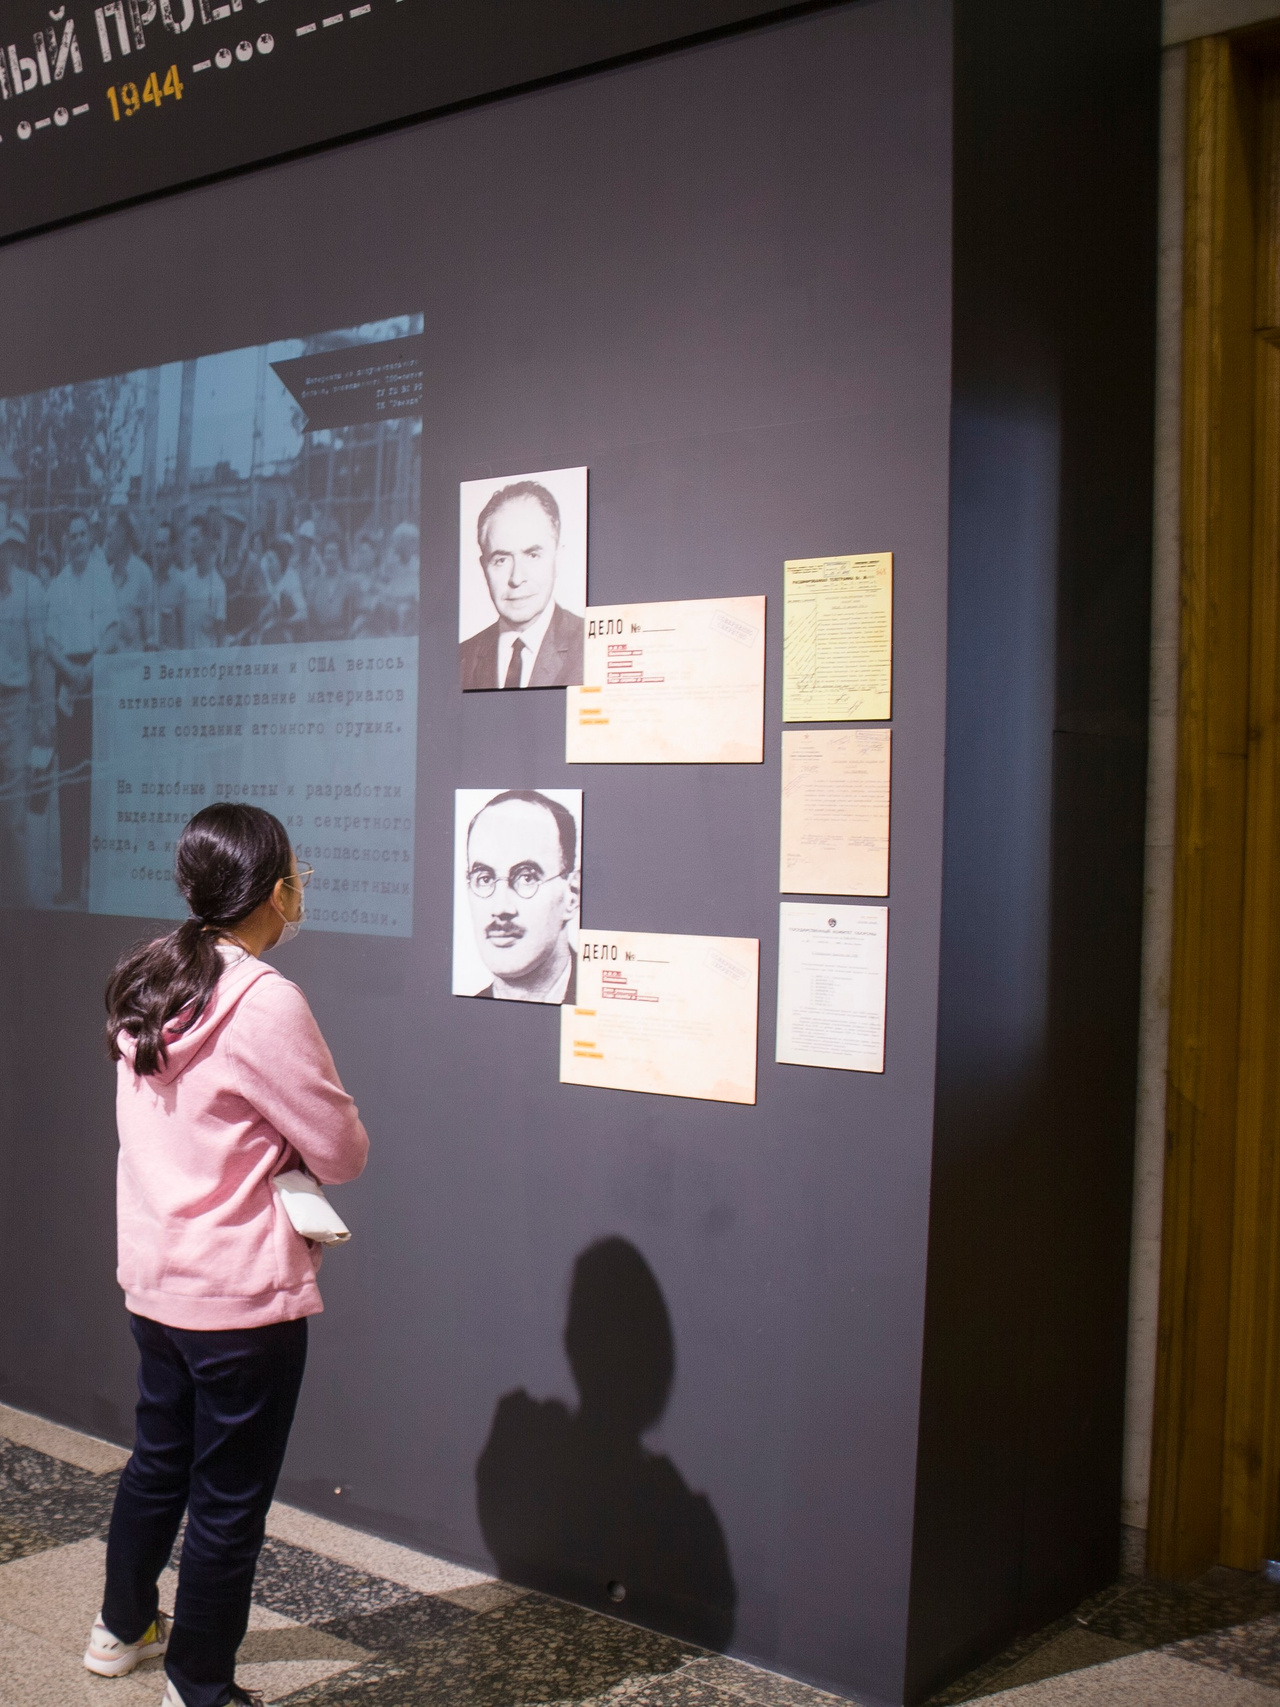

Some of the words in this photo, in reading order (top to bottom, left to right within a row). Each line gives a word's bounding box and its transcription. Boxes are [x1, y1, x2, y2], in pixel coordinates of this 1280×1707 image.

[106, 64, 184, 122] 1944
[587, 618, 624, 640] ДЕЛО
[143, 665, 151, 680] В
[160, 661, 279, 681] Великобритании
[289, 662, 297, 674] и
[308, 656, 336, 673] США
[346, 656, 405, 672] велось
[119, 696, 182, 710] активное
[191, 691, 297, 708] исследование
[307, 688, 405, 707] материалов
[142, 726, 166, 739] для
[174, 724, 243, 738] создания
[251, 722, 325, 736] атомного
[335, 721, 402, 738] оружия.
[117, 779, 132, 796] На
[141, 780, 206, 797] подобные
[216, 782, 278, 799] проекты
[287, 784, 295, 797] и
[305, 782, 402, 800] разработки
[286, 815, 304, 828] из
[314, 815, 413, 832] секретного
[91, 835, 138, 852] фонда,
[147, 840, 155, 851] а
[295, 843, 411, 863] безопасность
[582, 943, 618, 963] ДЕЛО
